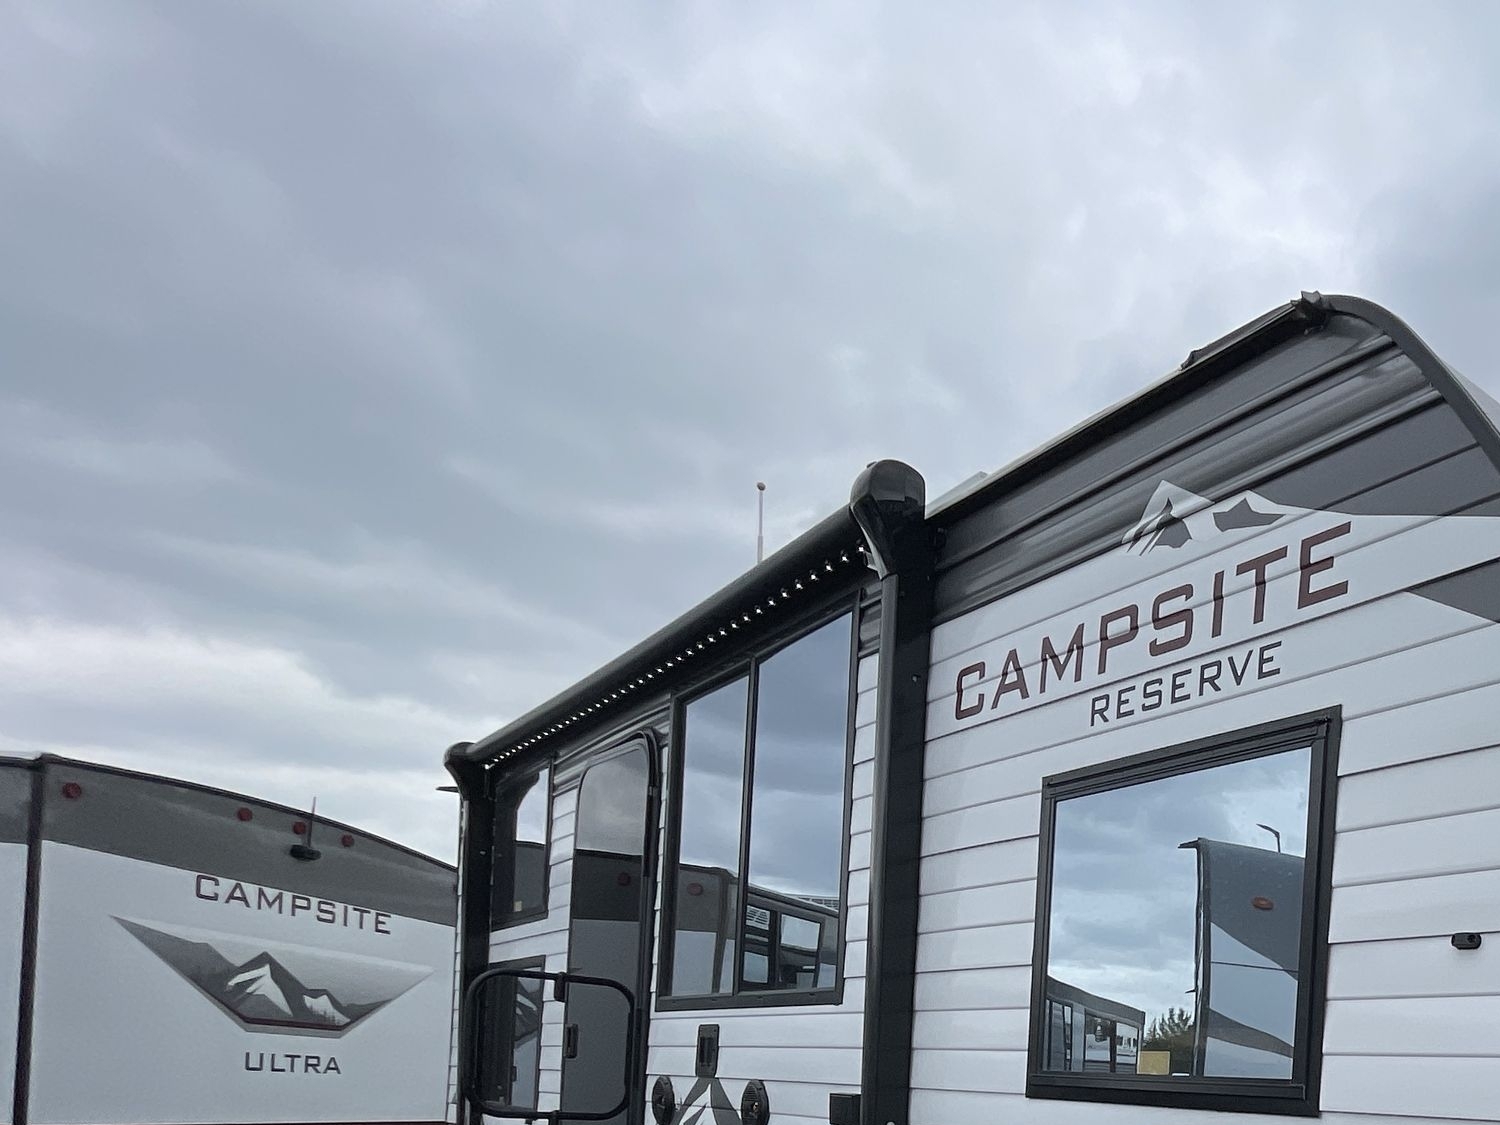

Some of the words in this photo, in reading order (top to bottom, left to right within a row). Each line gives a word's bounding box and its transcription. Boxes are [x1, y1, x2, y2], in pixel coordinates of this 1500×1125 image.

[954, 520, 1352, 722] CAMPSITE
[1090, 640, 1283, 727] RESERVE
[195, 874, 392, 935] CAMPSITE
[244, 1051, 342, 1075] ULTRA
